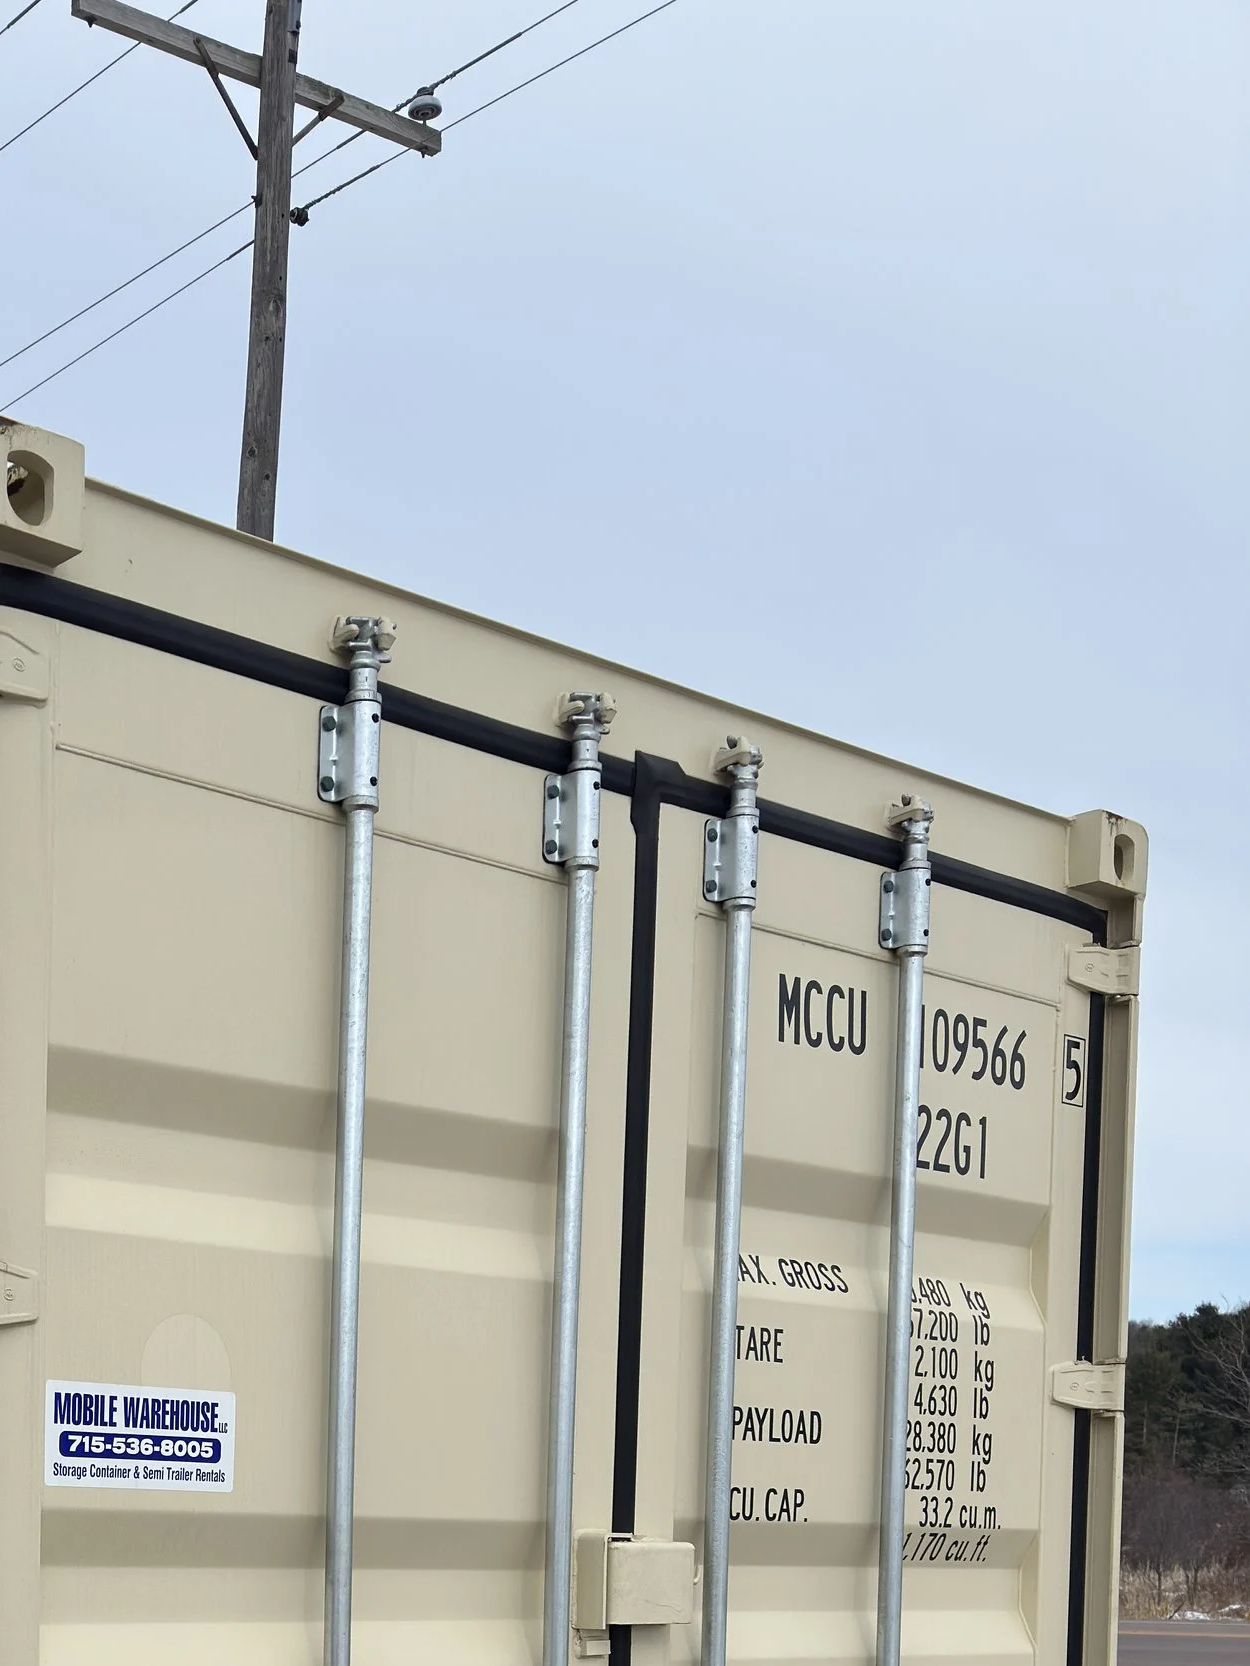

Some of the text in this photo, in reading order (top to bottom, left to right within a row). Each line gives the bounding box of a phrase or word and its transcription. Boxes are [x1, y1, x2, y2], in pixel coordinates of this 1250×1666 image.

[779, 974, 866, 1055] MCCU
[1065, 1041, 1082, 1101] 5
[916, 1105, 986, 1179] 22G1
[738, 1254, 776, 1285] AX.
[778, 1259, 848, 1293] GROSS
[960, 1283, 990, 1319] kg
[910, 1308, 990, 1346] 7,200 lb
[736, 1326, 994, 1392] TARE 2,100 kg
[54, 1392, 228, 1434] MOBILE WAREHOUSE LLC
[914, 1383, 989, 1419] 4,630 lb
[68, 1435, 213, 1459] 715-536-8005
[732, 1406, 821, 1444] PAYLOAD
[972, 1425, 992, 1464] kg
[54, 1462, 225, 1482] Storage Container & Semi Trailer Rentals
[971, 1460, 988, 1492] lb
[919, 1496, 953, 1528] 33.2
